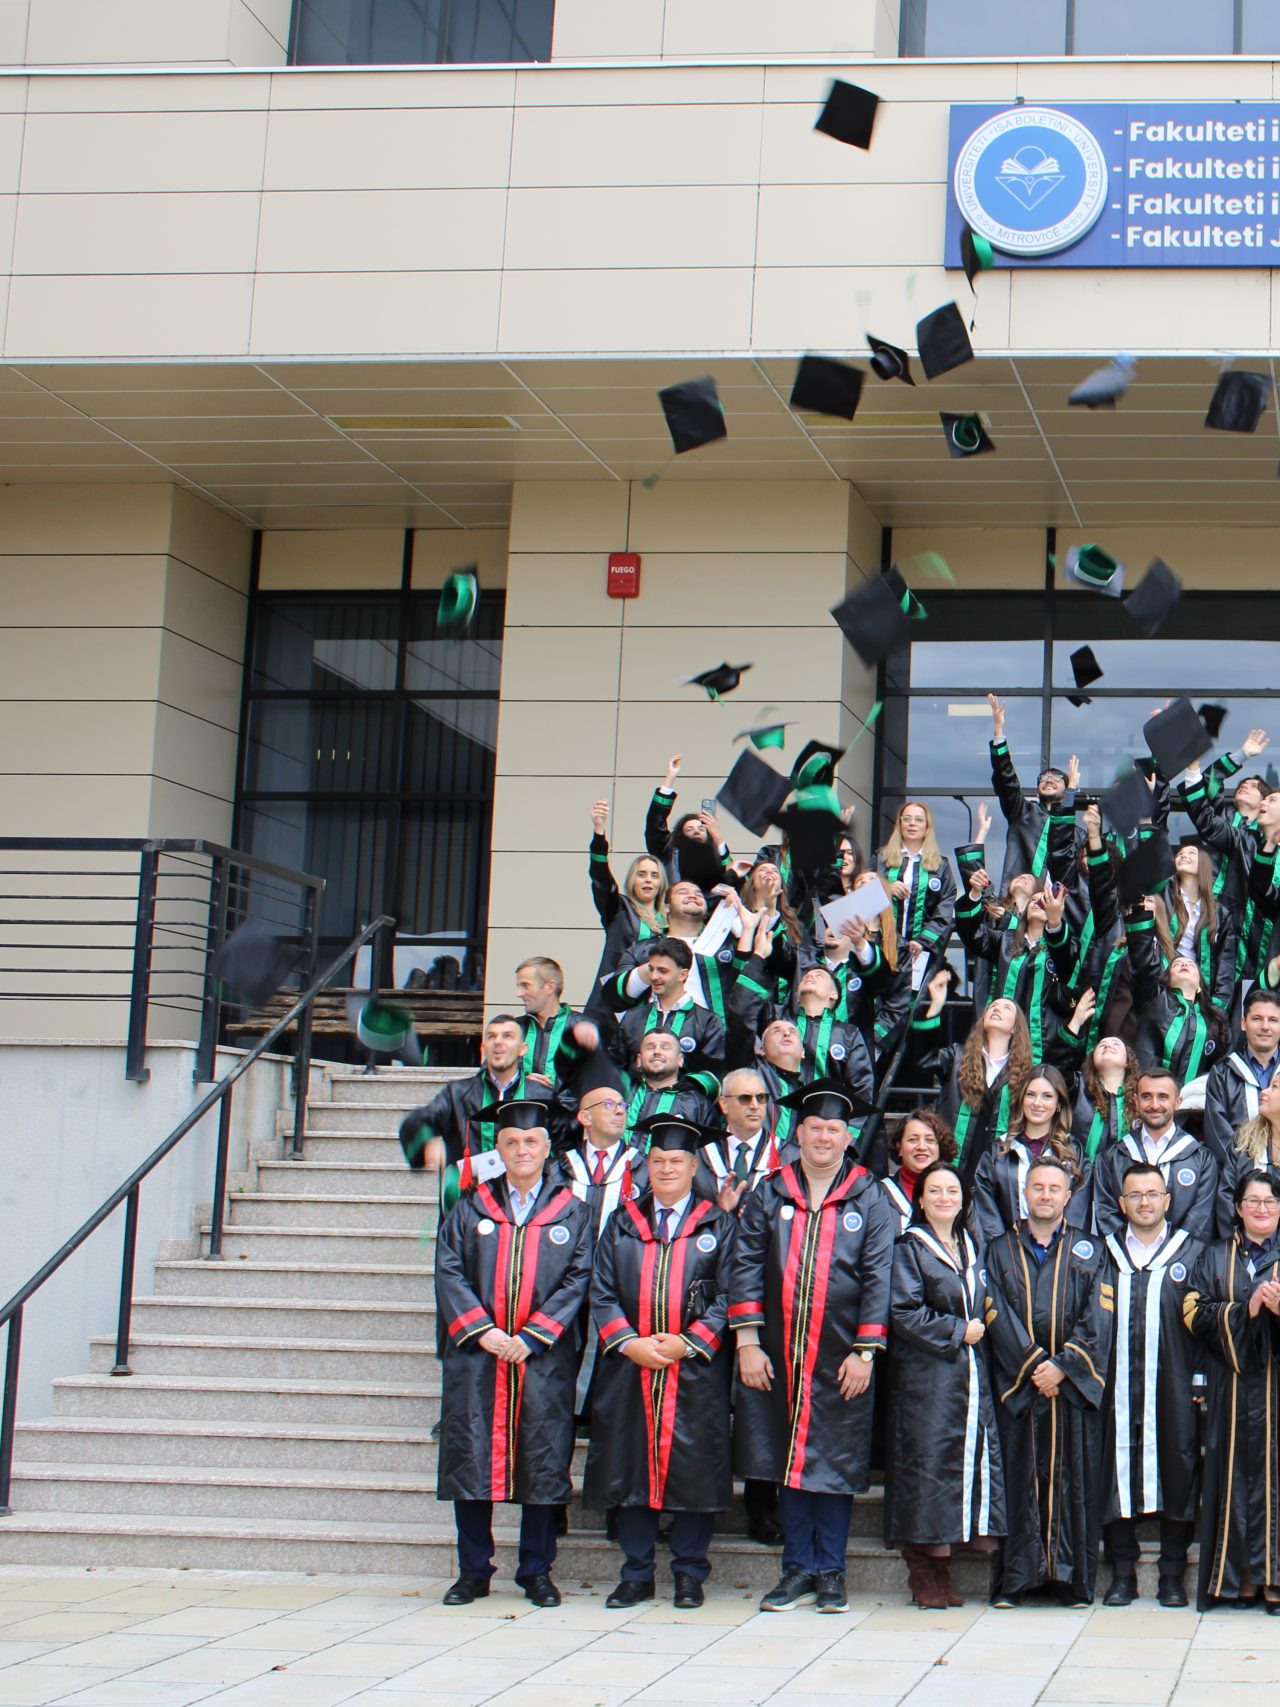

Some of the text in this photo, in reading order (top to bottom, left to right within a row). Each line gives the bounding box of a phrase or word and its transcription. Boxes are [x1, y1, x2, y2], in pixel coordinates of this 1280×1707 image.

[1130, 118, 1266, 142] Fakulteti
[1271, 118, 1279, 142] i
[961, 135, 988, 212] UNIVERSITETI
[1073, 133, 1099, 209] UNIVERSITY
[1129, 156, 1265, 179] Fakulteti
[1272, 156, 1280, 179] i
[1128, 192, 1264, 215] Fakulteti
[1271, 192, 1279, 215] i
[1127, 224, 1264, 247] Fakulteti
[610, 566, 635, 574] FUEGO
